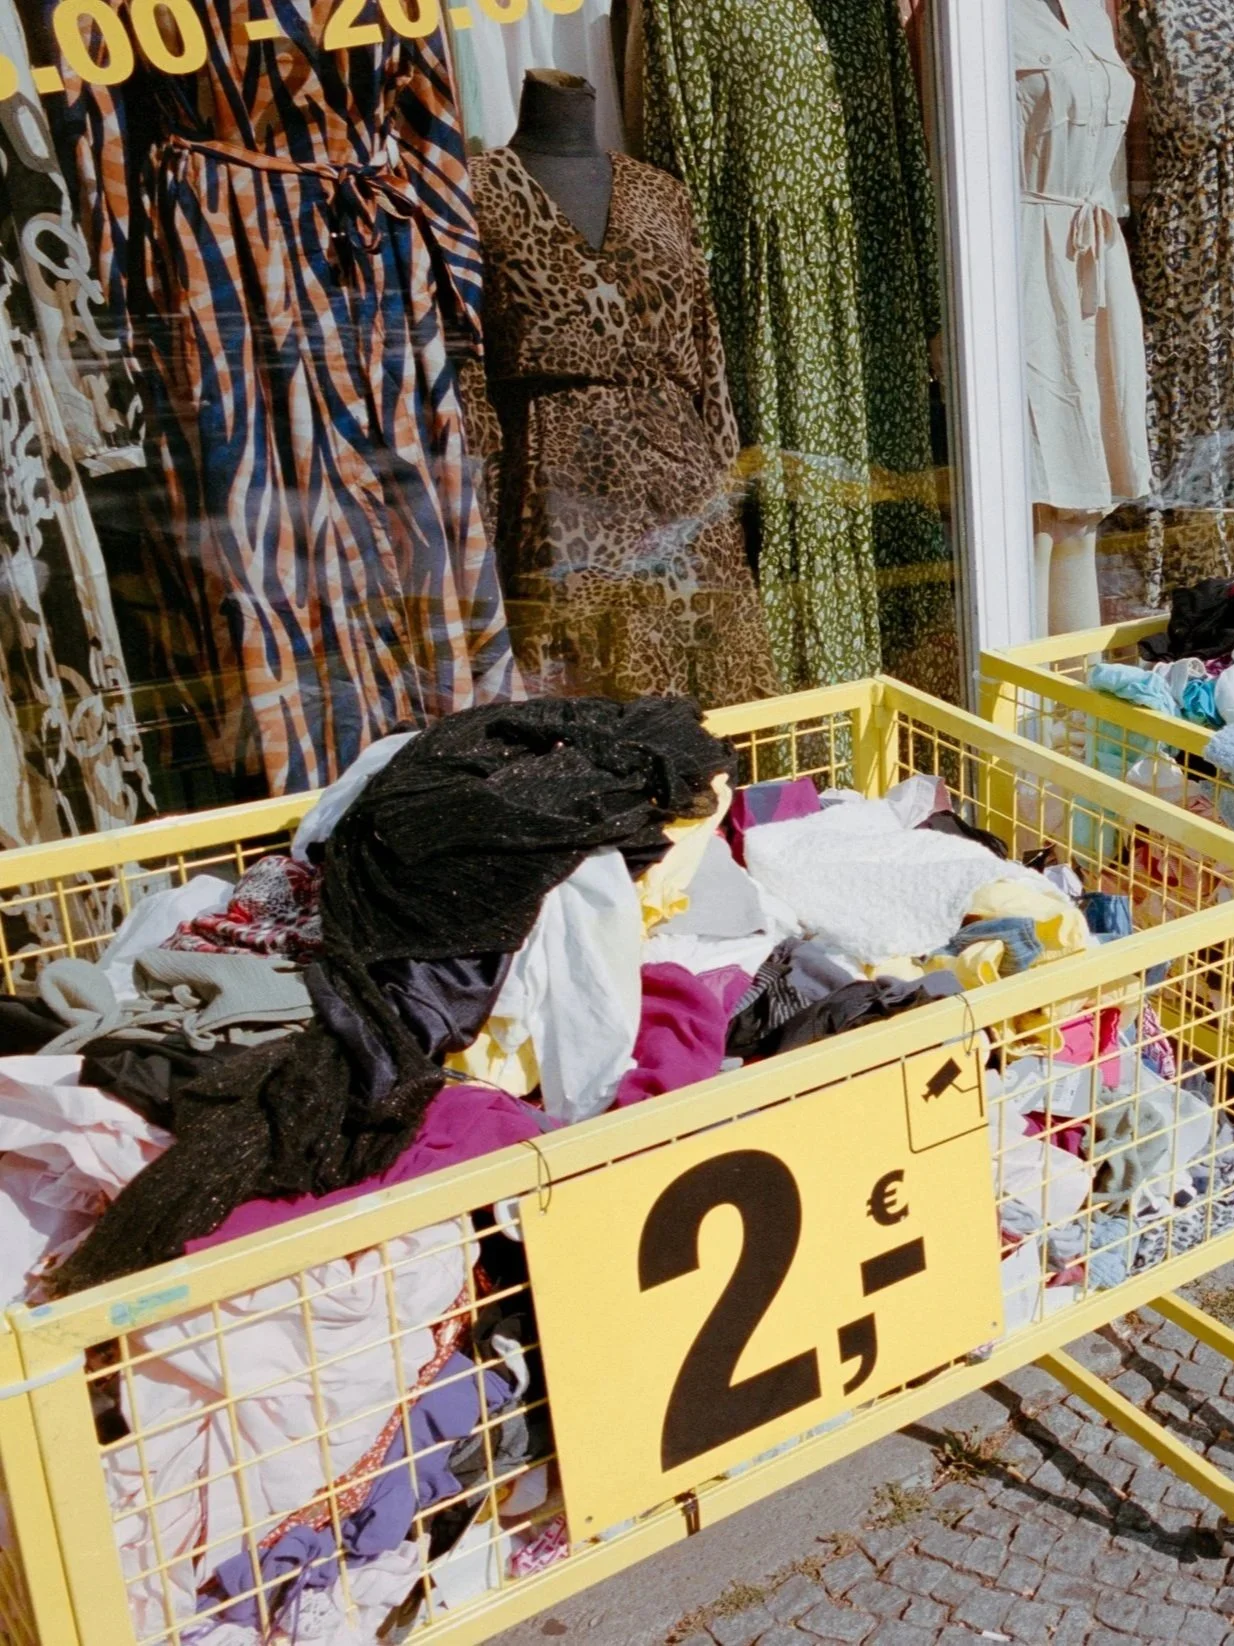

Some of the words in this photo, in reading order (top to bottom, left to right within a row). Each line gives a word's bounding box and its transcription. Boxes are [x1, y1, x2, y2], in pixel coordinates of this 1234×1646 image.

[0, 0, 208, 100] .00
[244, 19, 280, 41] -
[866, 1169, 909, 1226] €
